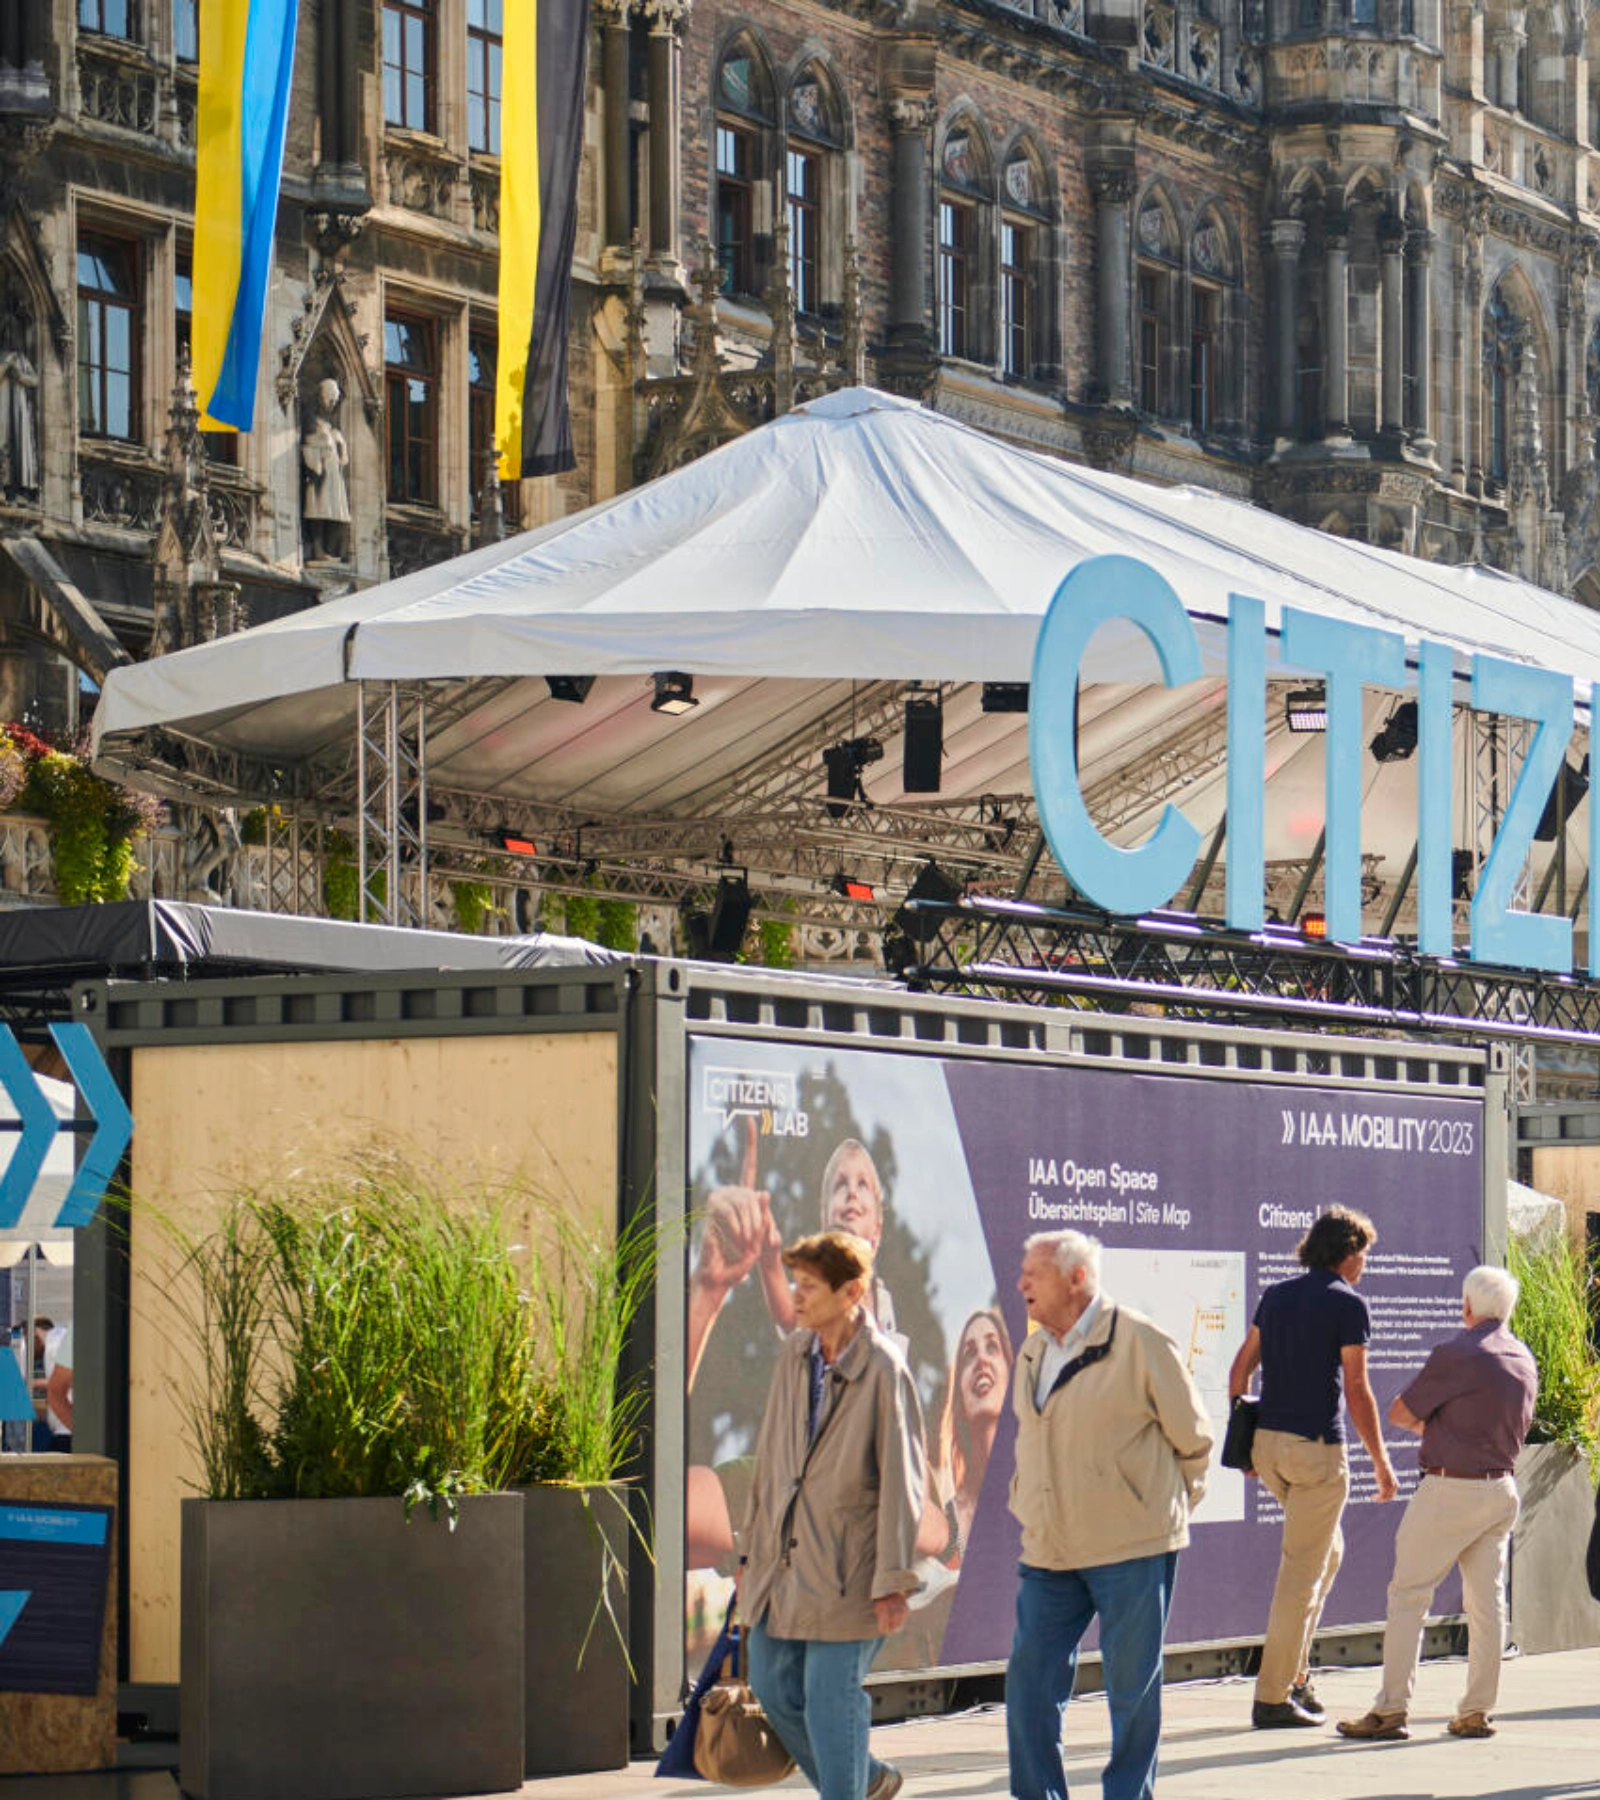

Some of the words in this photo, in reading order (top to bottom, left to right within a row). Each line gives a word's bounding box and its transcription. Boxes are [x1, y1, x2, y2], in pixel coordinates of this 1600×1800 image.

[710, 1078, 787, 1106] CITIZENS
[772, 1112, 809, 1137] LAB
[1301, 1112, 1338, 1145] IAA
[1341, 1114, 1427, 1152] MOBILITY
[1429, 1119, 1474, 1155] 2023
[1029, 1158, 1059, 1185] IAA
[1062, 1159, 1106, 1193] Open
[1110, 1162, 1158, 1196] Space
[1029, 1192, 1127, 1227] Übersichtsplan
[1136, 1202, 1160, 1224] Site
[1163, 1203, 1190, 1230] Map
[1258, 1202, 1313, 1229] Citizens
